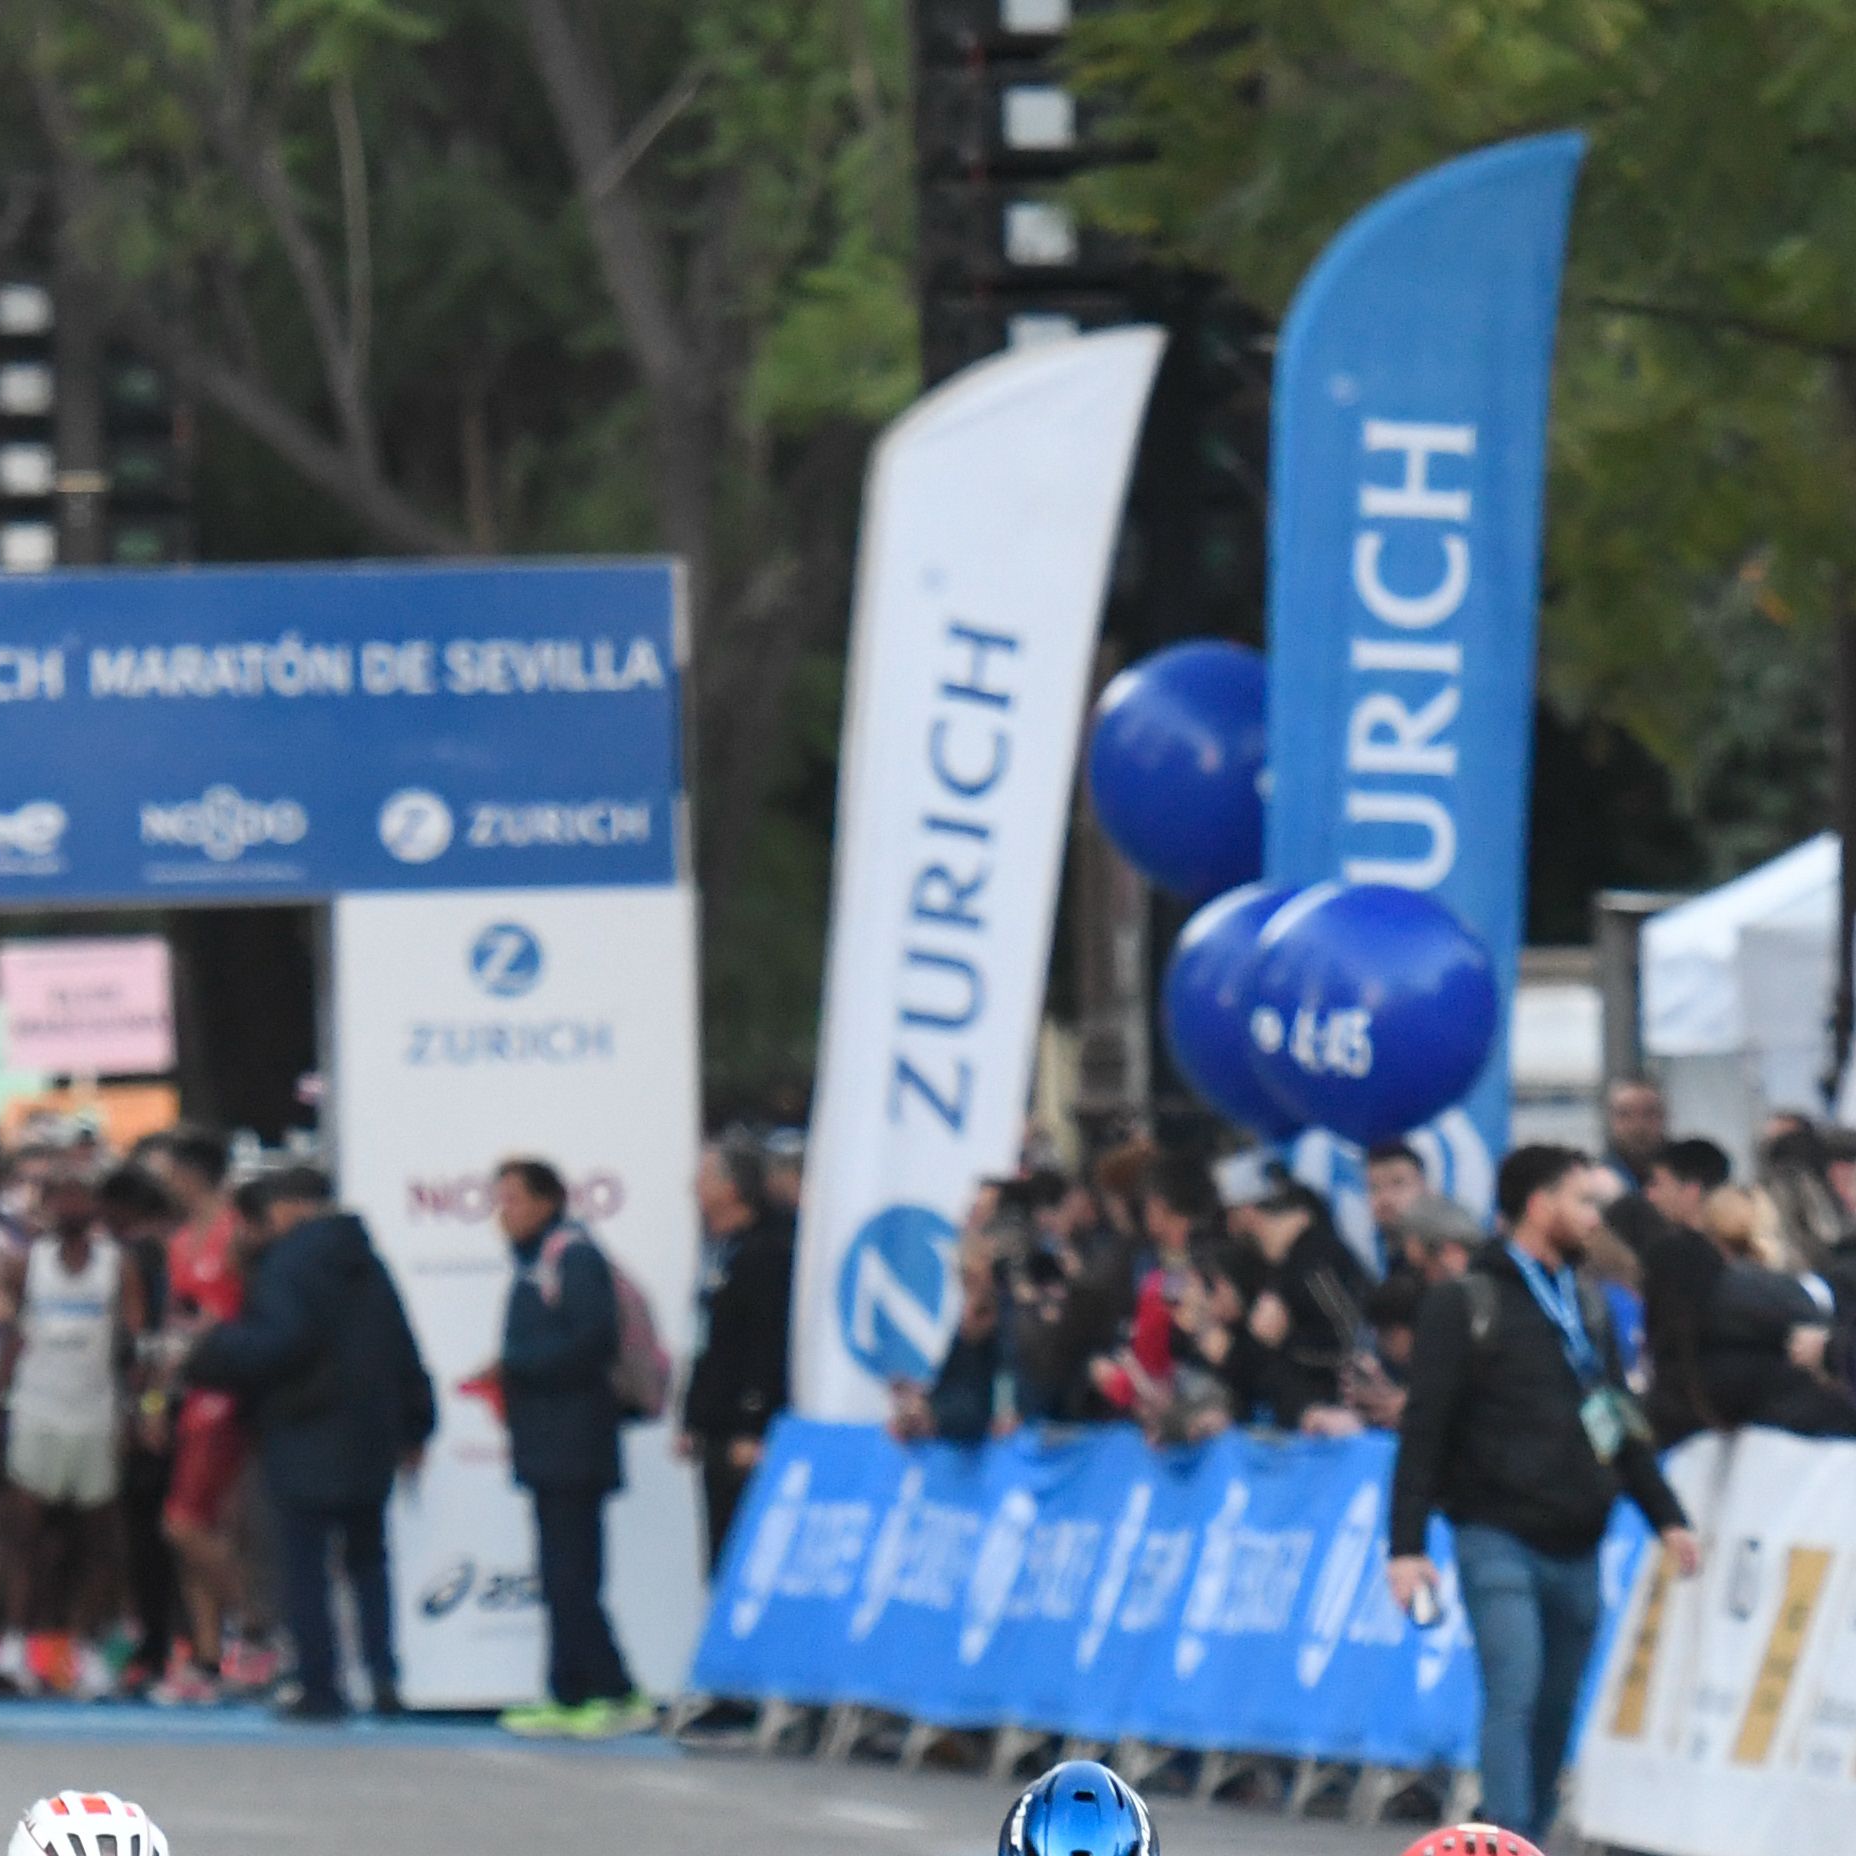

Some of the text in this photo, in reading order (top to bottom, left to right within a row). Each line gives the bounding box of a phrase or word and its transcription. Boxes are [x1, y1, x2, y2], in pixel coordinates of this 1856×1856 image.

[91, 629, 347, 698] MARATÓN
[360, 642, 433, 695] DE
[443, 639, 665, 693] SEVILLA
[1344, 417, 1479, 891] URICH
[466, 803, 651, 846] ZURICH
[887, 615, 1025, 1138] ZURICH
[405, 1017, 616, 1069] ZURICH
